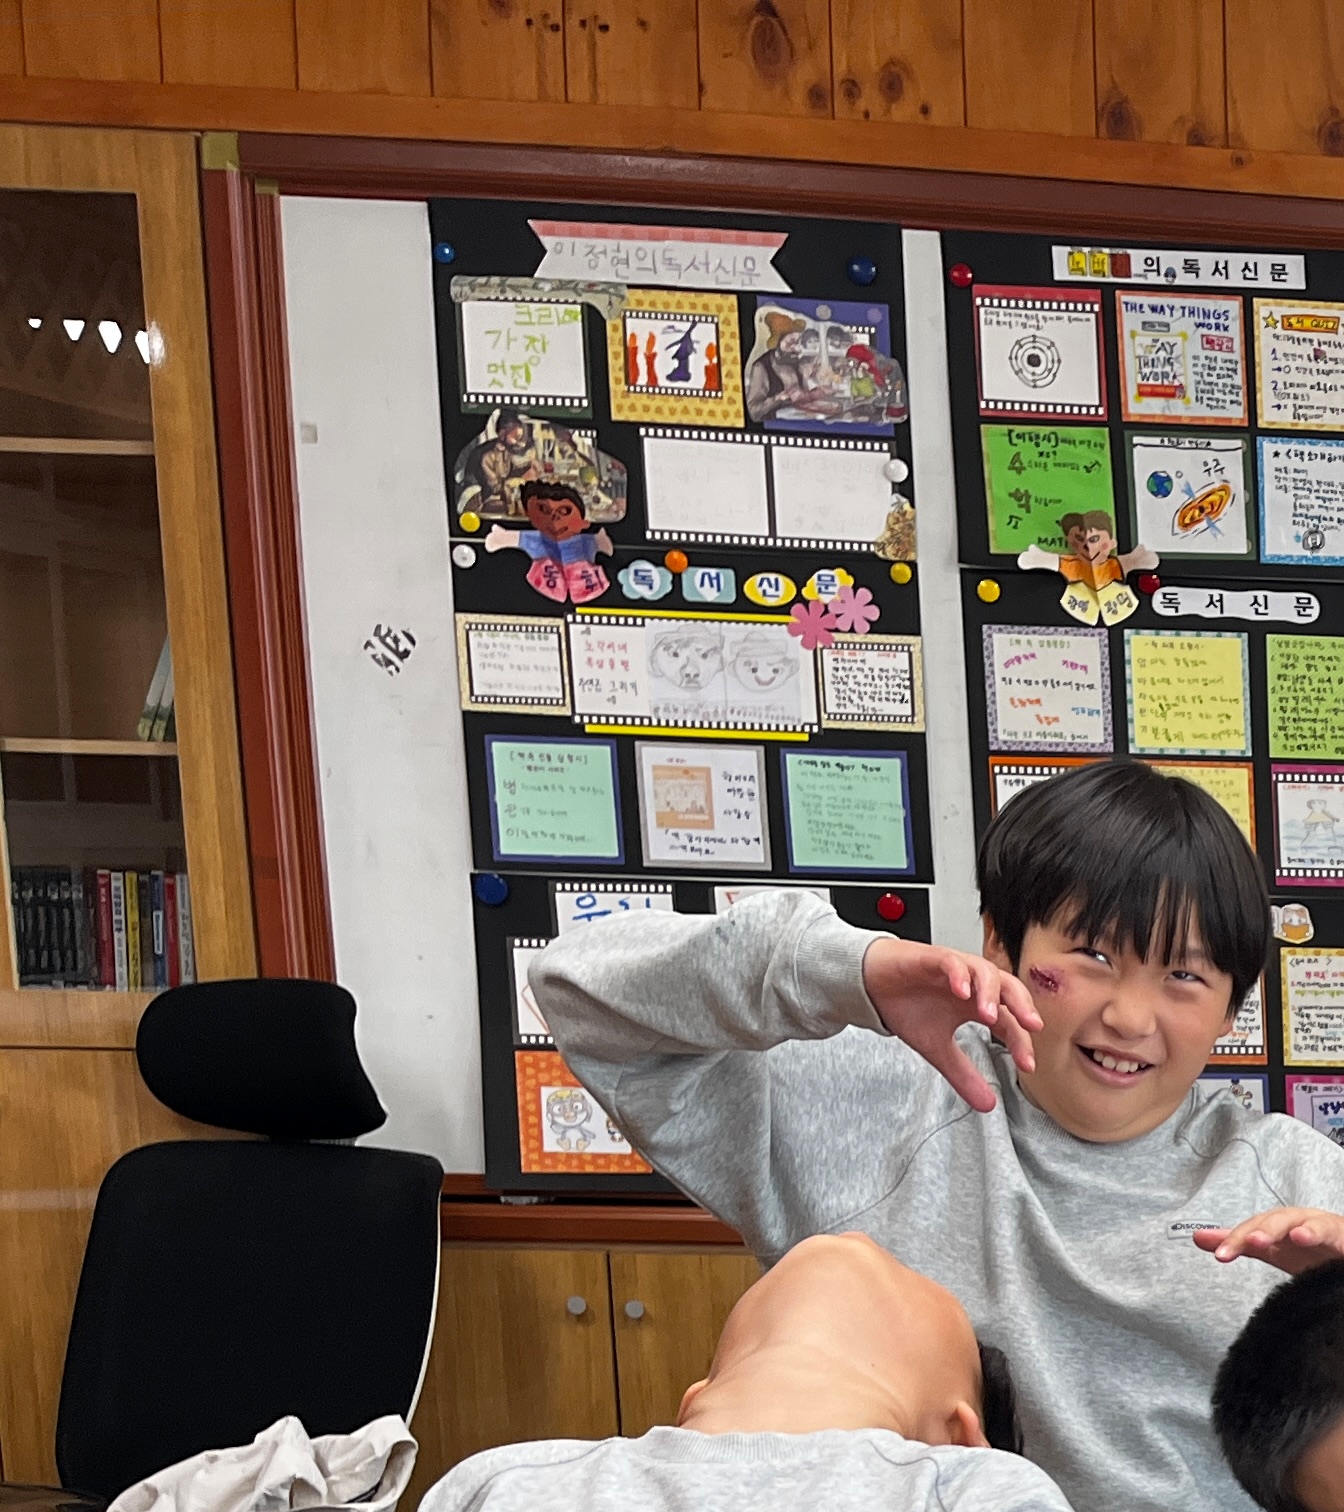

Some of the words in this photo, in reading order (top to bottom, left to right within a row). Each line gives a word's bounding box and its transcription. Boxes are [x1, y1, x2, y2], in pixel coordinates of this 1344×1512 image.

[1143, 256, 1161, 277] 의
[1123, 301, 1145, 314] THE
[1148, 303, 1175, 318] WAY
[1180, 305, 1229, 321] THINGS
[1194, 321, 1229, 332] WORK
